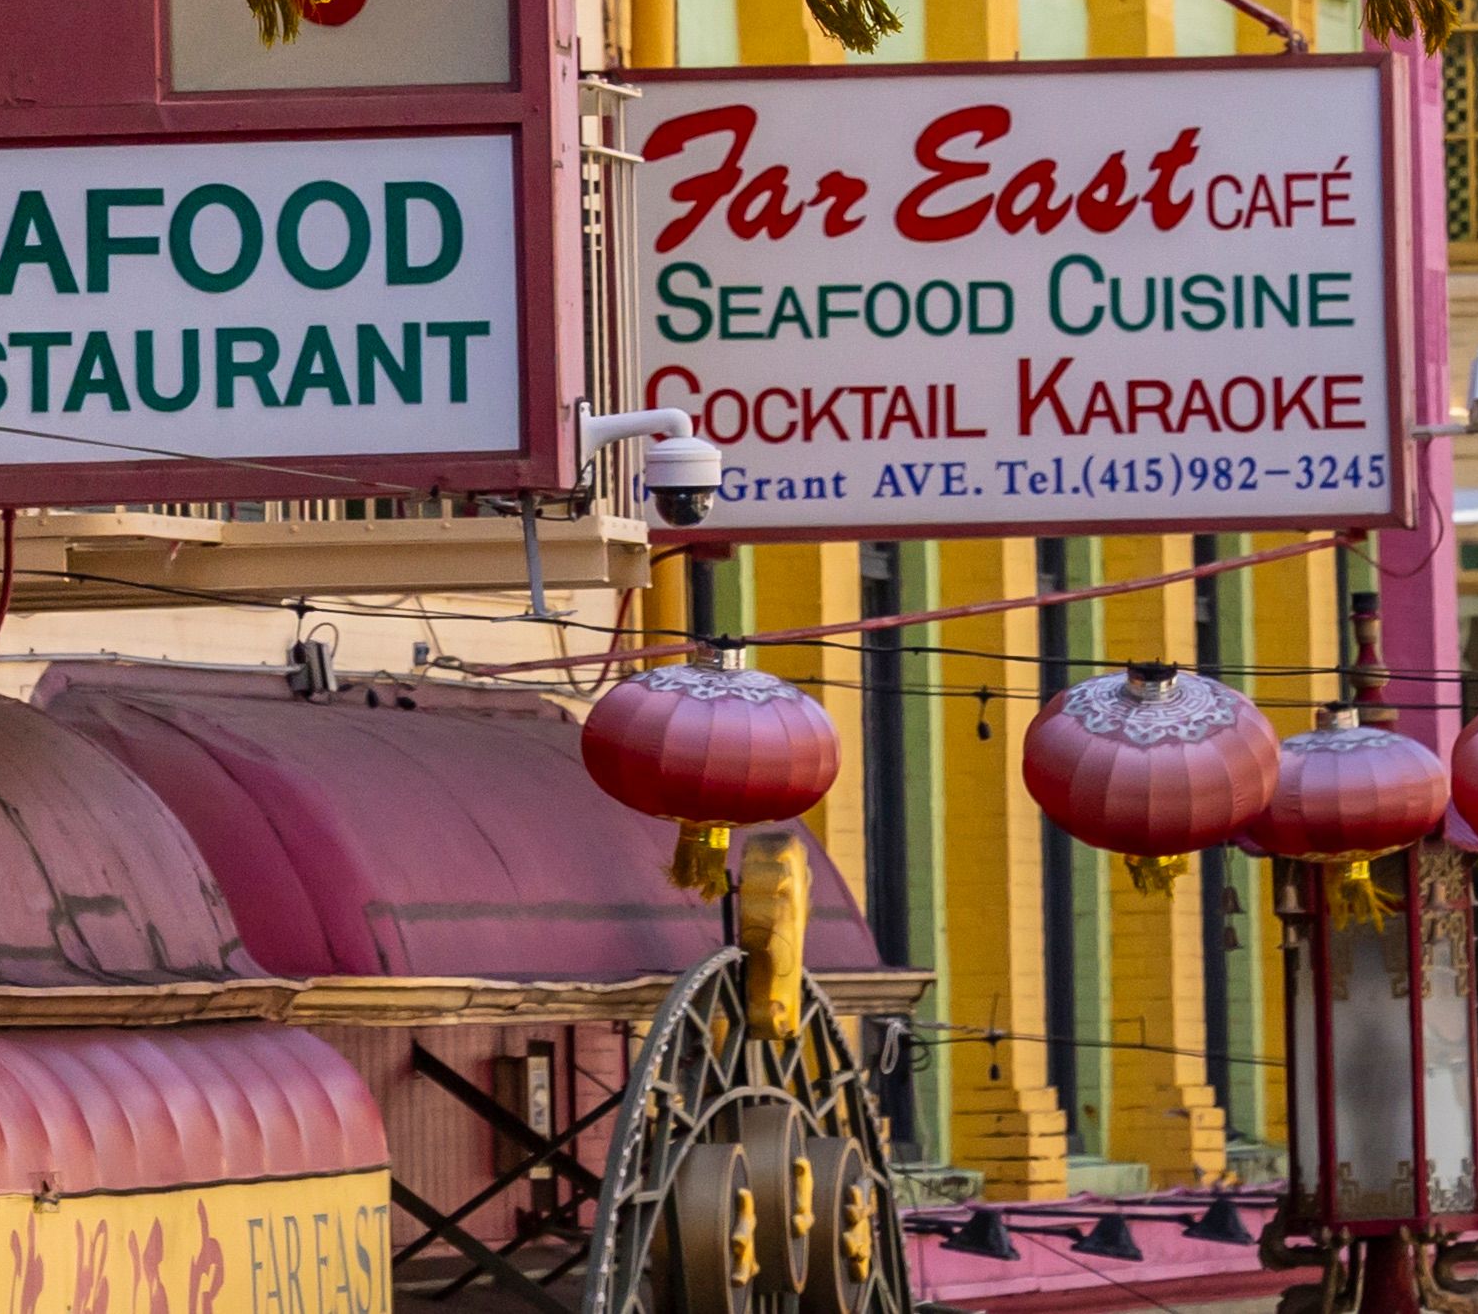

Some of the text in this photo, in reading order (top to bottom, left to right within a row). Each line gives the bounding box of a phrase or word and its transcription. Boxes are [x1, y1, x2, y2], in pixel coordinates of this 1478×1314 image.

[641, 104, 1357, 254] Far East CAFÉ
[720, 465, 847, 502] Grant
[872, 461, 984, 499] AVE.
